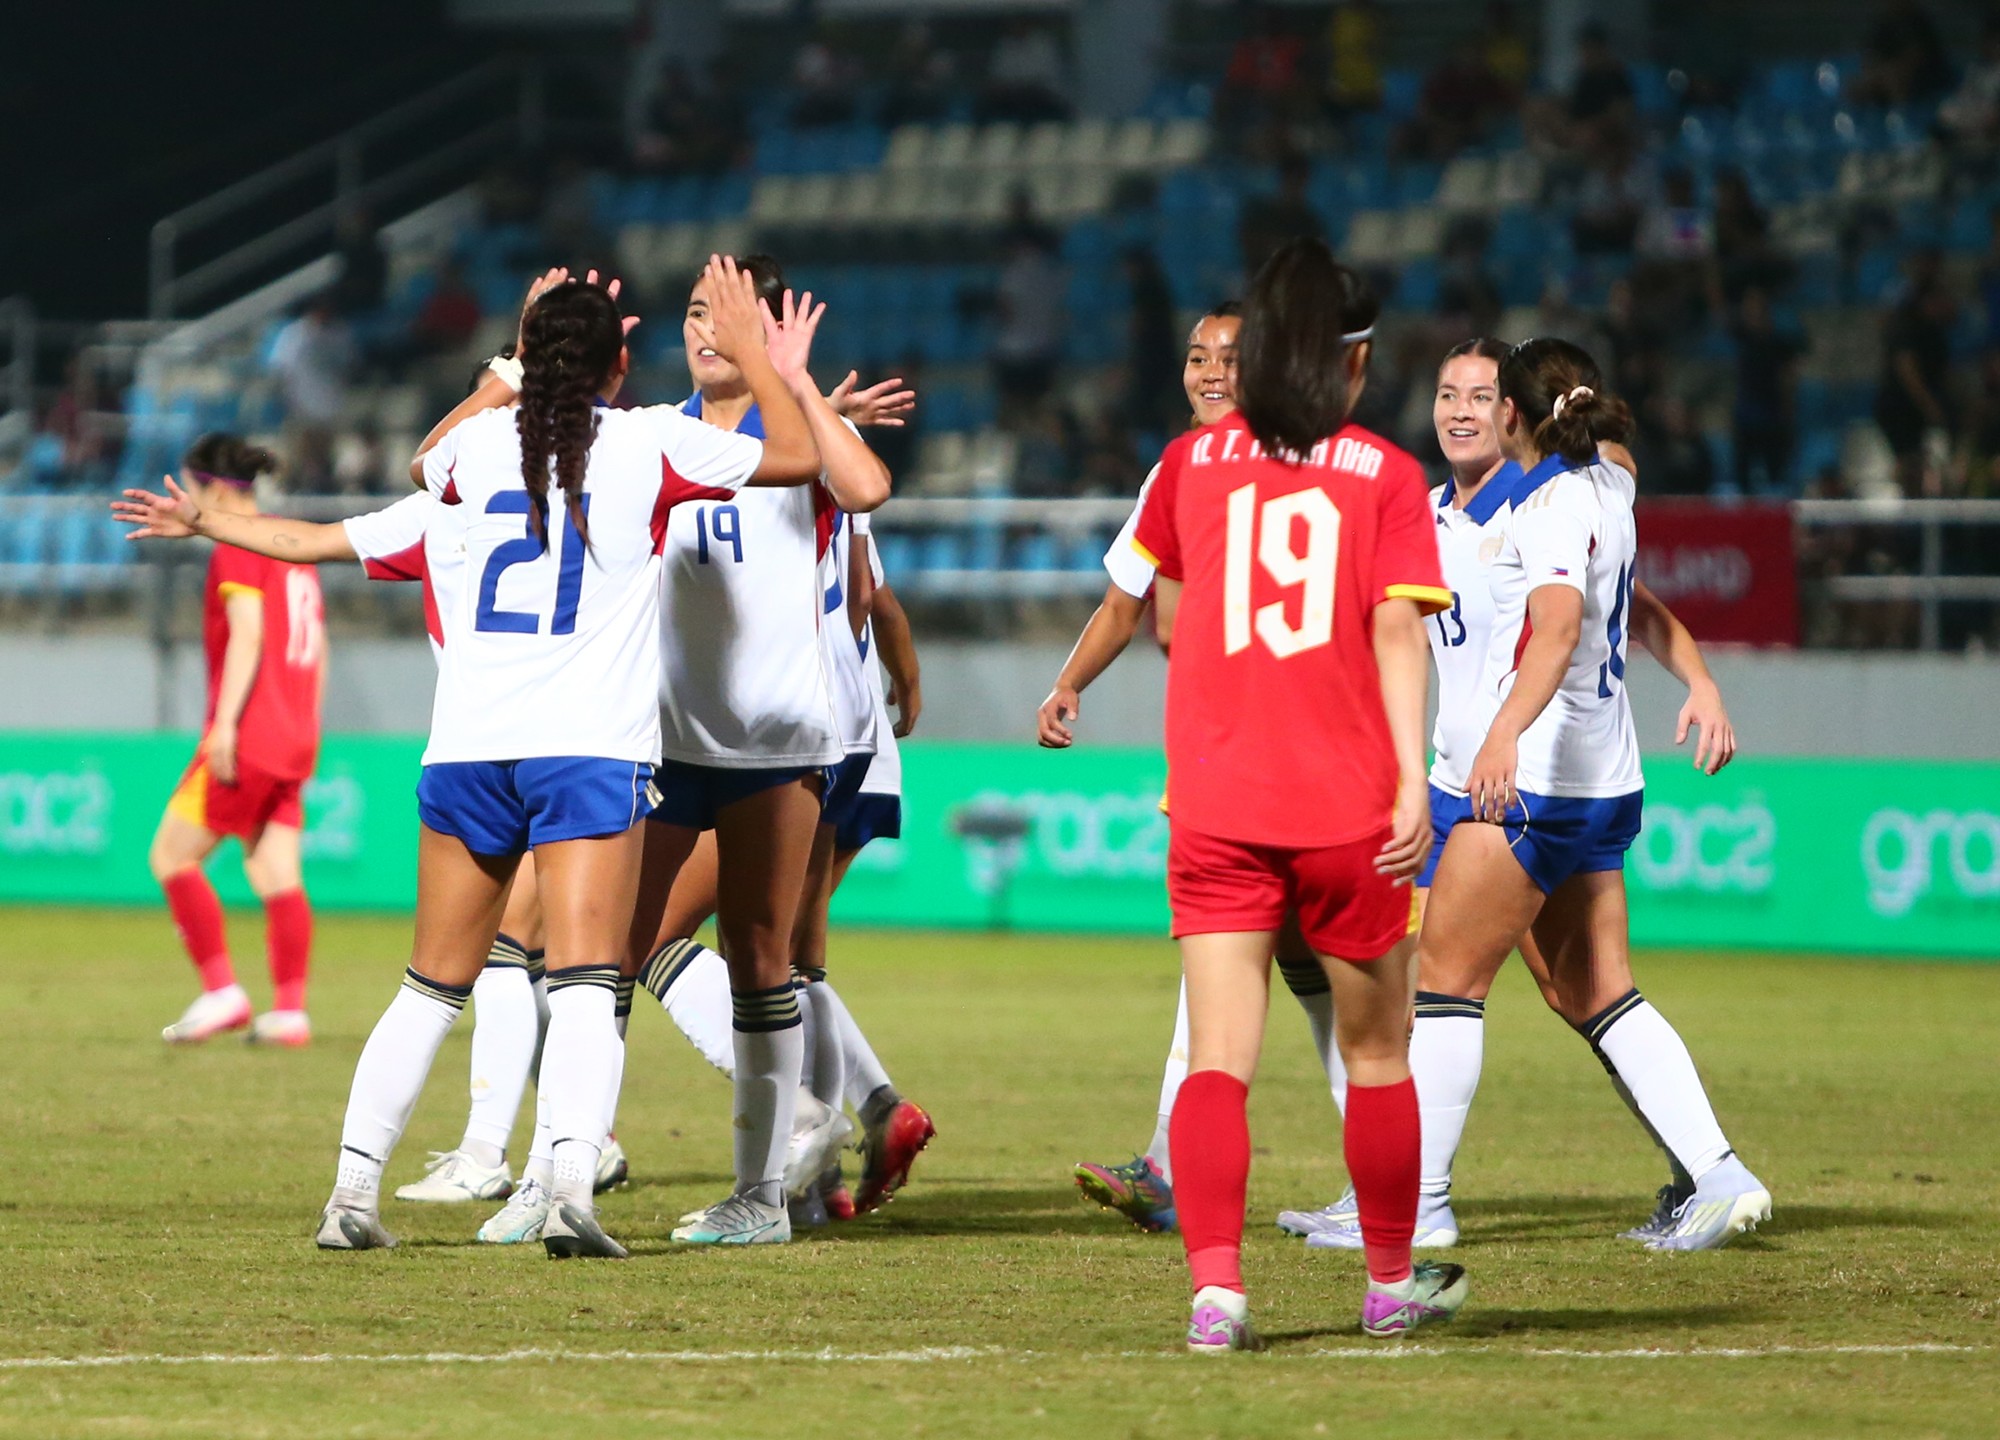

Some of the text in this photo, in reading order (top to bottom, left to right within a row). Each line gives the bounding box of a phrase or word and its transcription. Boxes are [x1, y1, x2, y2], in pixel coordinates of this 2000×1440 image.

[1220, 429, 1242, 461] T.
[474, 489, 592, 636] 21
[696, 504, 744, 565] 19
[1224, 481, 1342, 661] 19
[1436, 591, 1467, 647] 13
